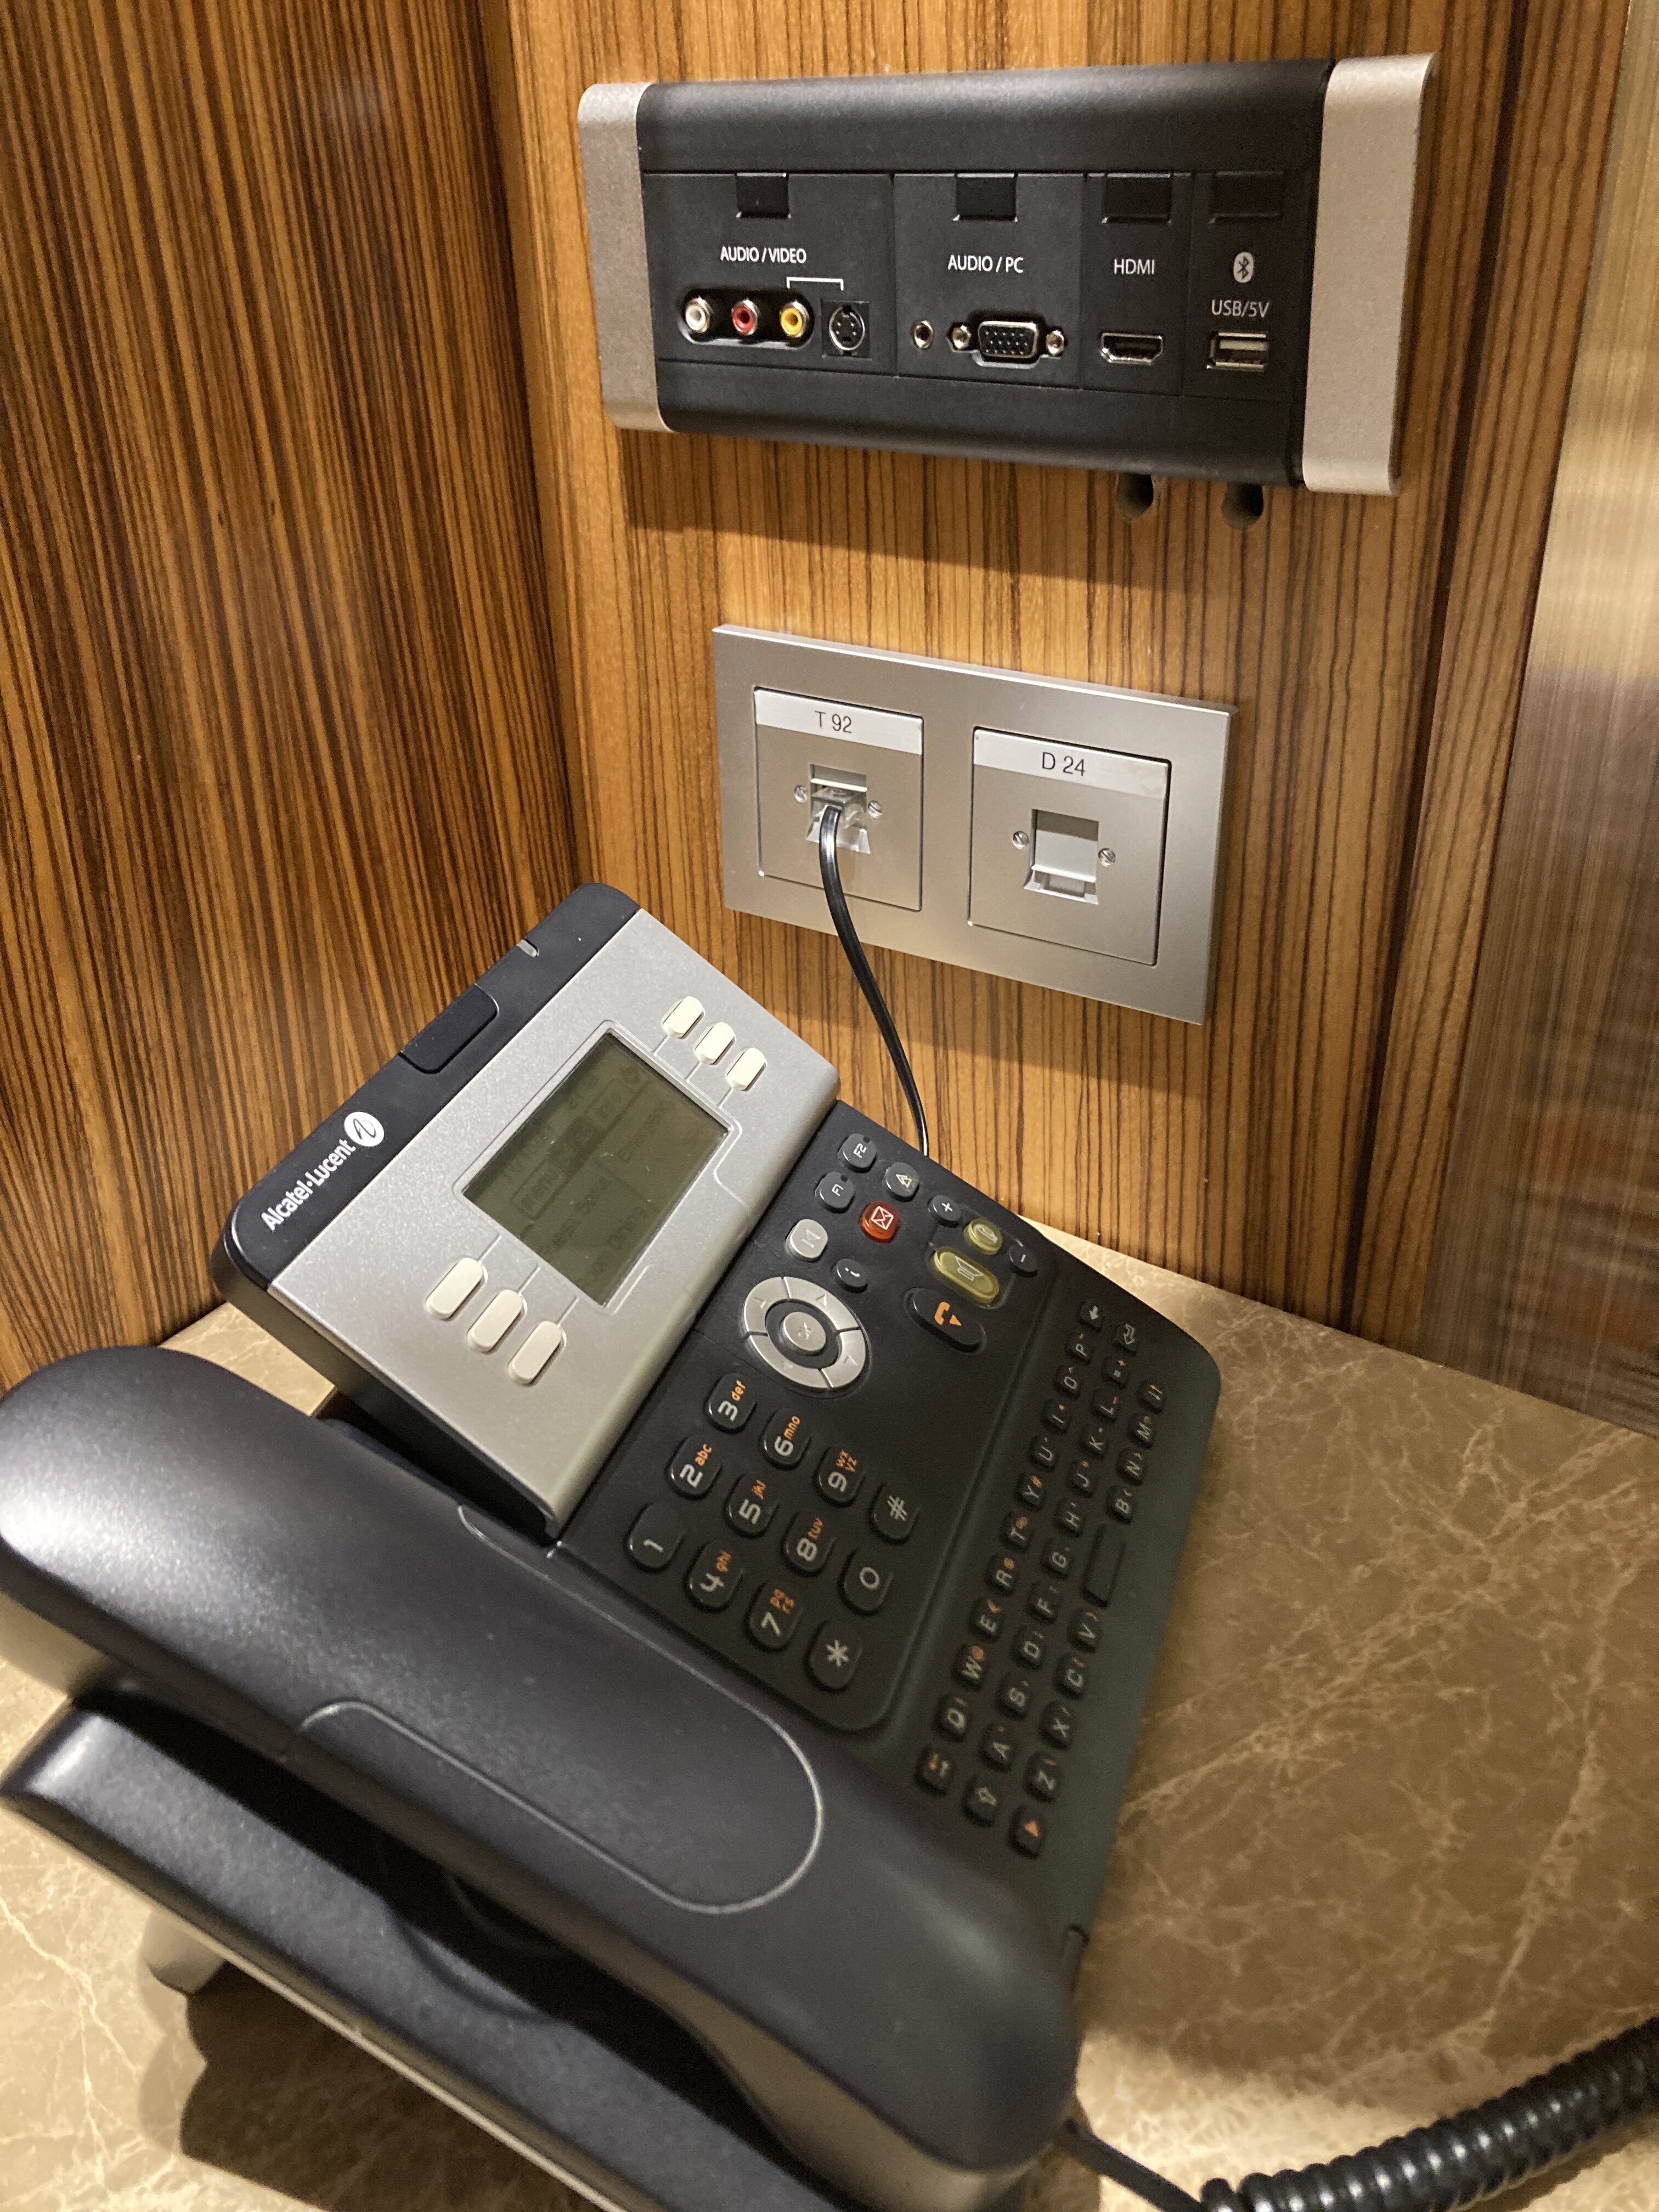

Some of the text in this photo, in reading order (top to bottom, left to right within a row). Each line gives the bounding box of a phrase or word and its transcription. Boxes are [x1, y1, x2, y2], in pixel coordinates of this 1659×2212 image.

[720, 246, 759, 262] AUDIO
[768, 247, 807, 264] VIDEO
[947, 254, 994, 272] AUDIO
[1005, 256, 1024, 274] PC
[1114, 258, 1155, 275] HDMI
[1211, 299, 1269, 318] USB/5V
[814, 710, 852, 733] T 92
[1042, 752, 1085, 776] D 24
[853, 1142, 867, 1159] F2
[831, 1183, 844, 1197] F1
[718, 1380, 746, 1421] 3 def
[774, 1415, 800, 1456] 6 mno
[679, 1444, 712, 1487] 2 abc
[828, 1471, 847, 1492] 9
[738, 1499, 761, 1524] 5
[643, 1539, 663, 1552] 1
[797, 1538, 817, 1561] 8
[700, 1572, 724, 1592] 4
[761, 1612, 781, 1635] 7
